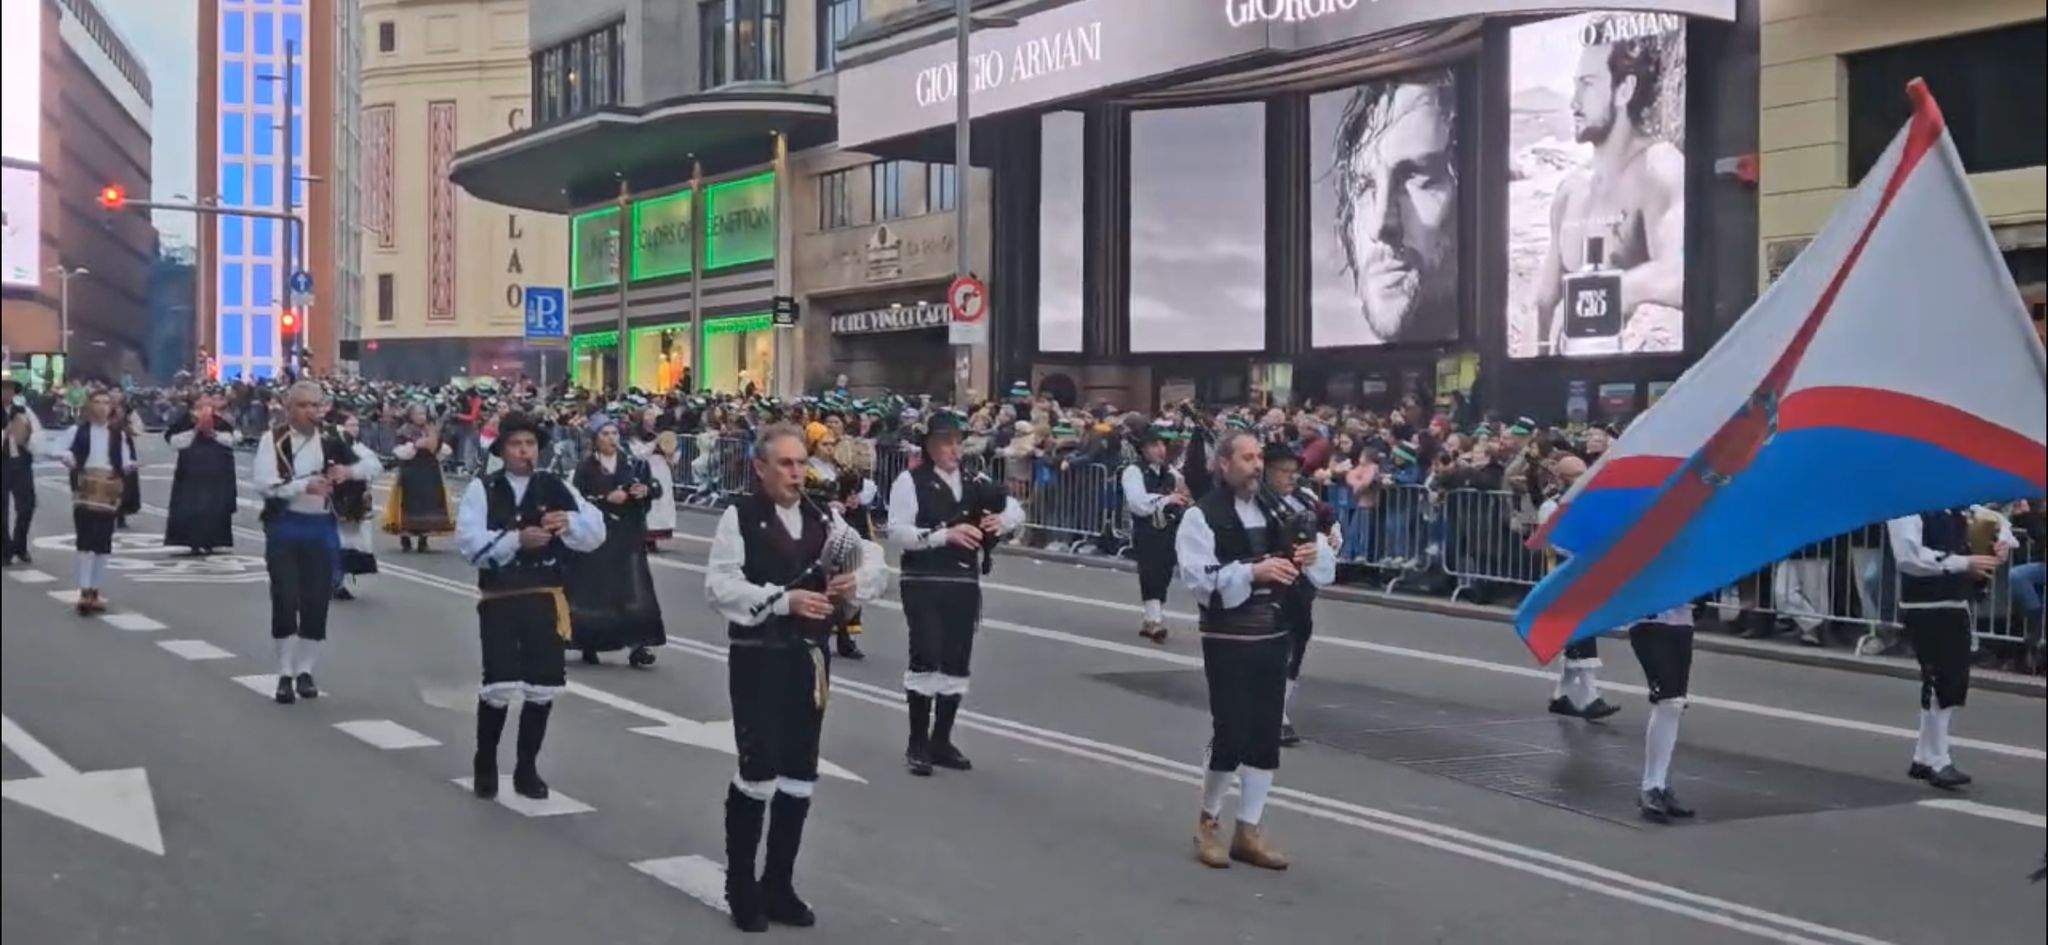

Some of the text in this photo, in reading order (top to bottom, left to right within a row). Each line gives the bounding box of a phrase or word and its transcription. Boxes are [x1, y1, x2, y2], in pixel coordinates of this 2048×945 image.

[1010, 22, 1101, 82] ARMANI
[506, 108, 524, 308] CLAO
[534, 295, 557, 328] P
